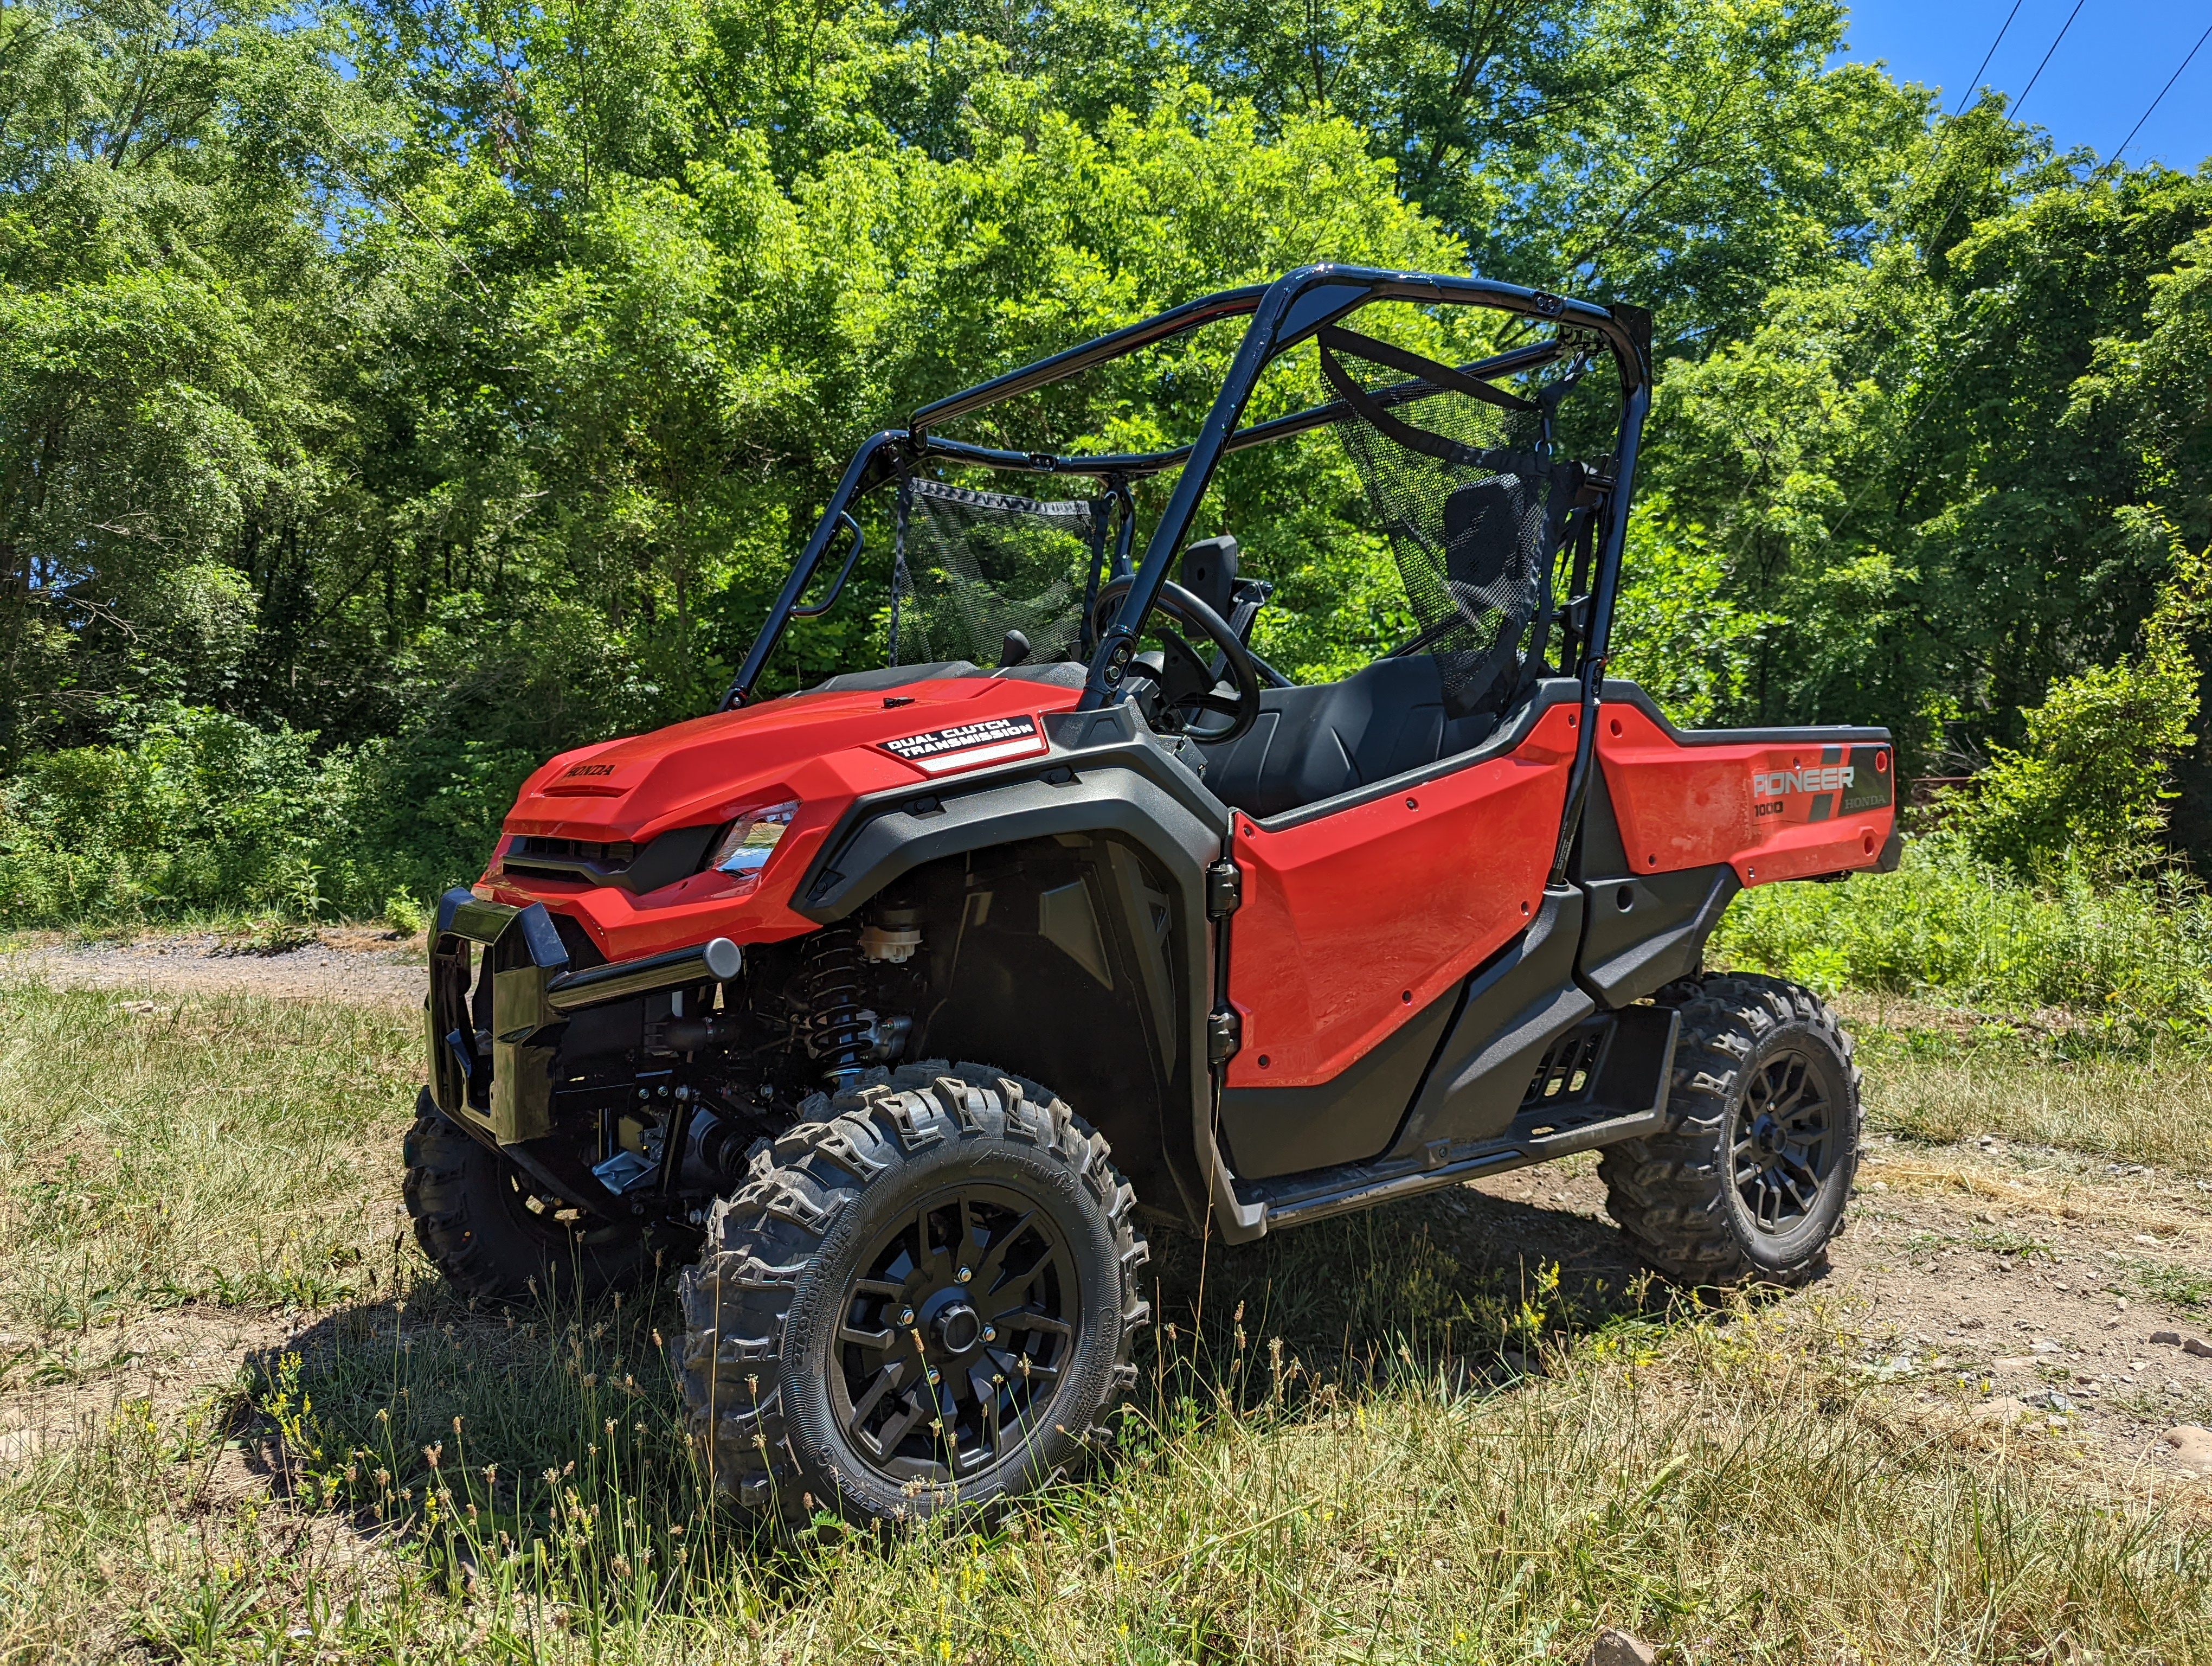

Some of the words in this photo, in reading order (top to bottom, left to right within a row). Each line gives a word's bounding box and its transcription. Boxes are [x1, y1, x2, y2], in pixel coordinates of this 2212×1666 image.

[888, 734, 938, 751] DUAL
[941, 719, 1011, 739] CLUTCH
[898, 725, 1034, 757] TRANSMISSION
[563, 765, 616, 777] HONDA
[1753, 766, 1854, 798] PIONEER
[1754, 801, 1784, 817] 1000
[1844, 795, 1886, 809] HONDA
[828, 1464, 913, 1520] ASTER
